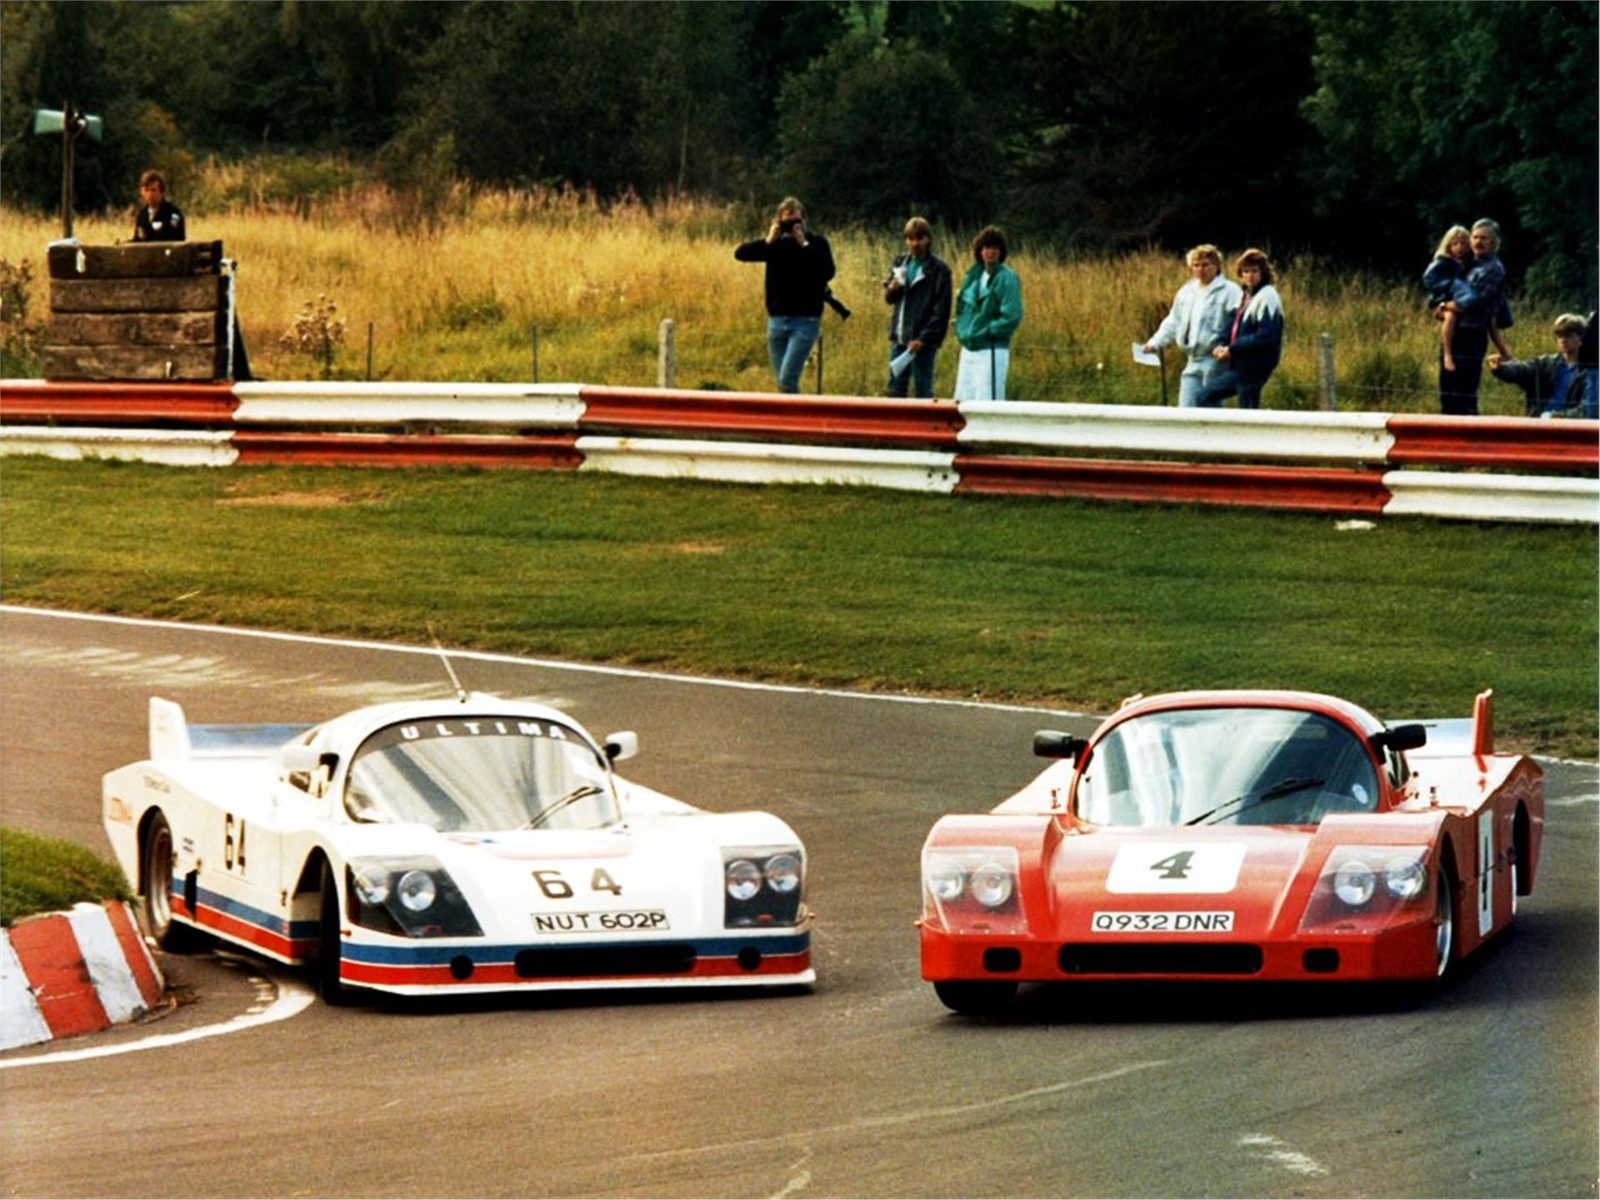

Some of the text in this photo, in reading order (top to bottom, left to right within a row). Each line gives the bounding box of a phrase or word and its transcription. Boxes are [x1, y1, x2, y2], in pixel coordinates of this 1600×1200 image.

[400, 721, 567, 740] ULTIMA
[225, 812, 246, 876] 64
[1149, 850, 1195, 879] 4
[531, 868, 623, 899] 64
[535, 913, 666, 931] NUT 602P
[1095, 914, 1231, 930] Q932 DNR
